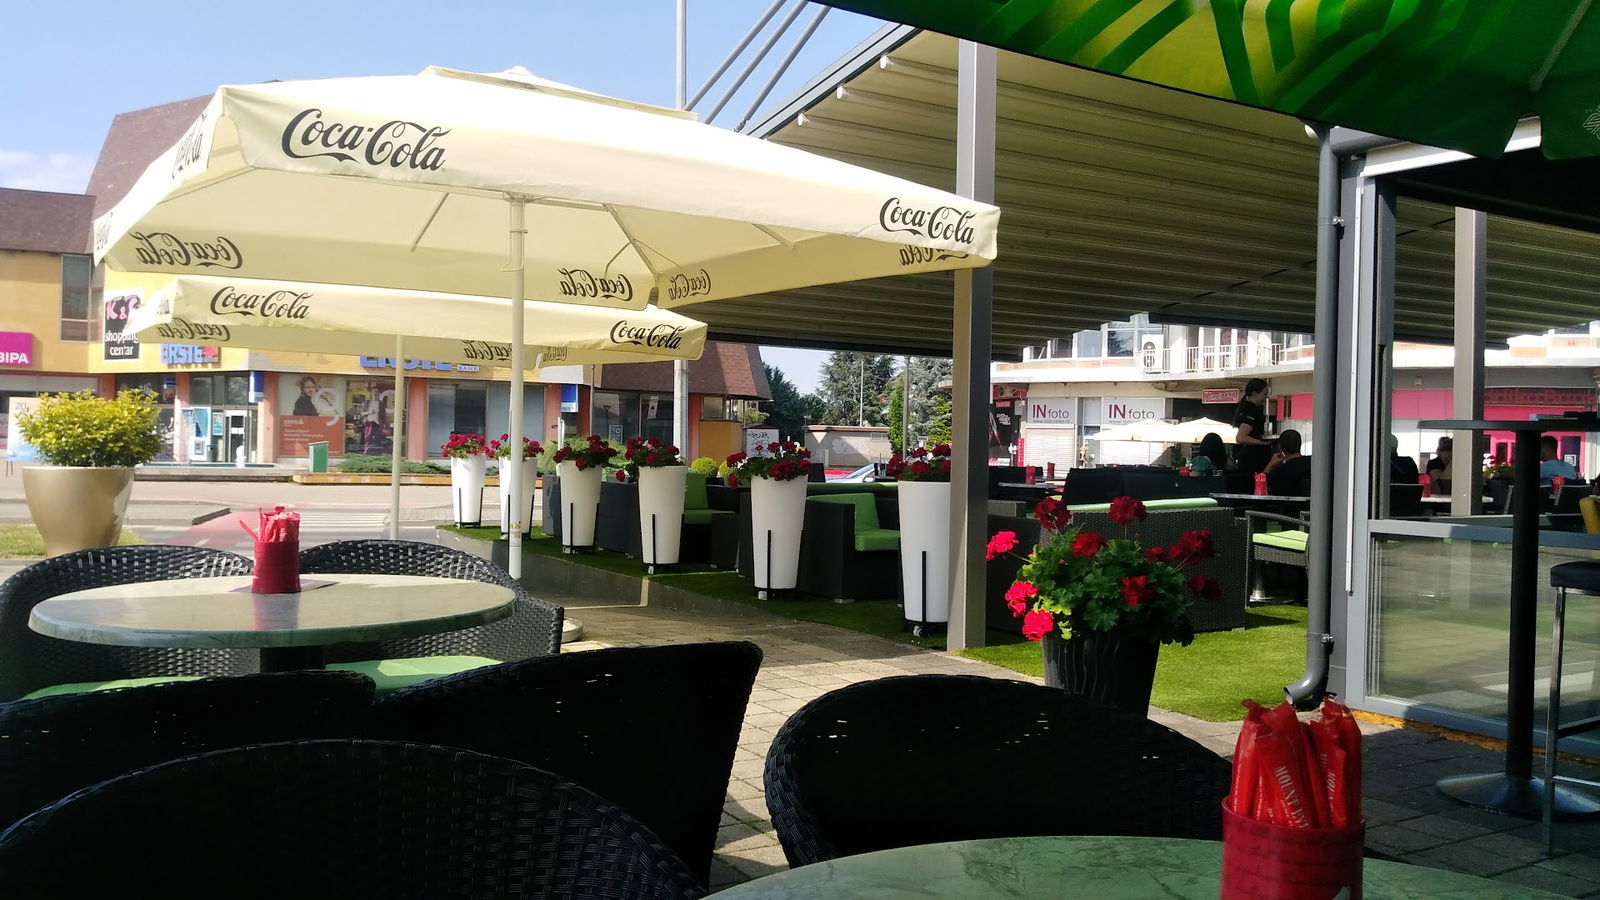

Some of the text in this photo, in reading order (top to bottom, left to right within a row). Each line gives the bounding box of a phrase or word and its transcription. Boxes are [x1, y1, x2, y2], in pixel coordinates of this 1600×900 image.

[282, 108, 452, 171] Coca-Cola
[880, 198, 977, 245] Coca-Cola
[211, 286, 314, 320] Coca-Cola
[610, 320, 687, 350] Coca-Cola
